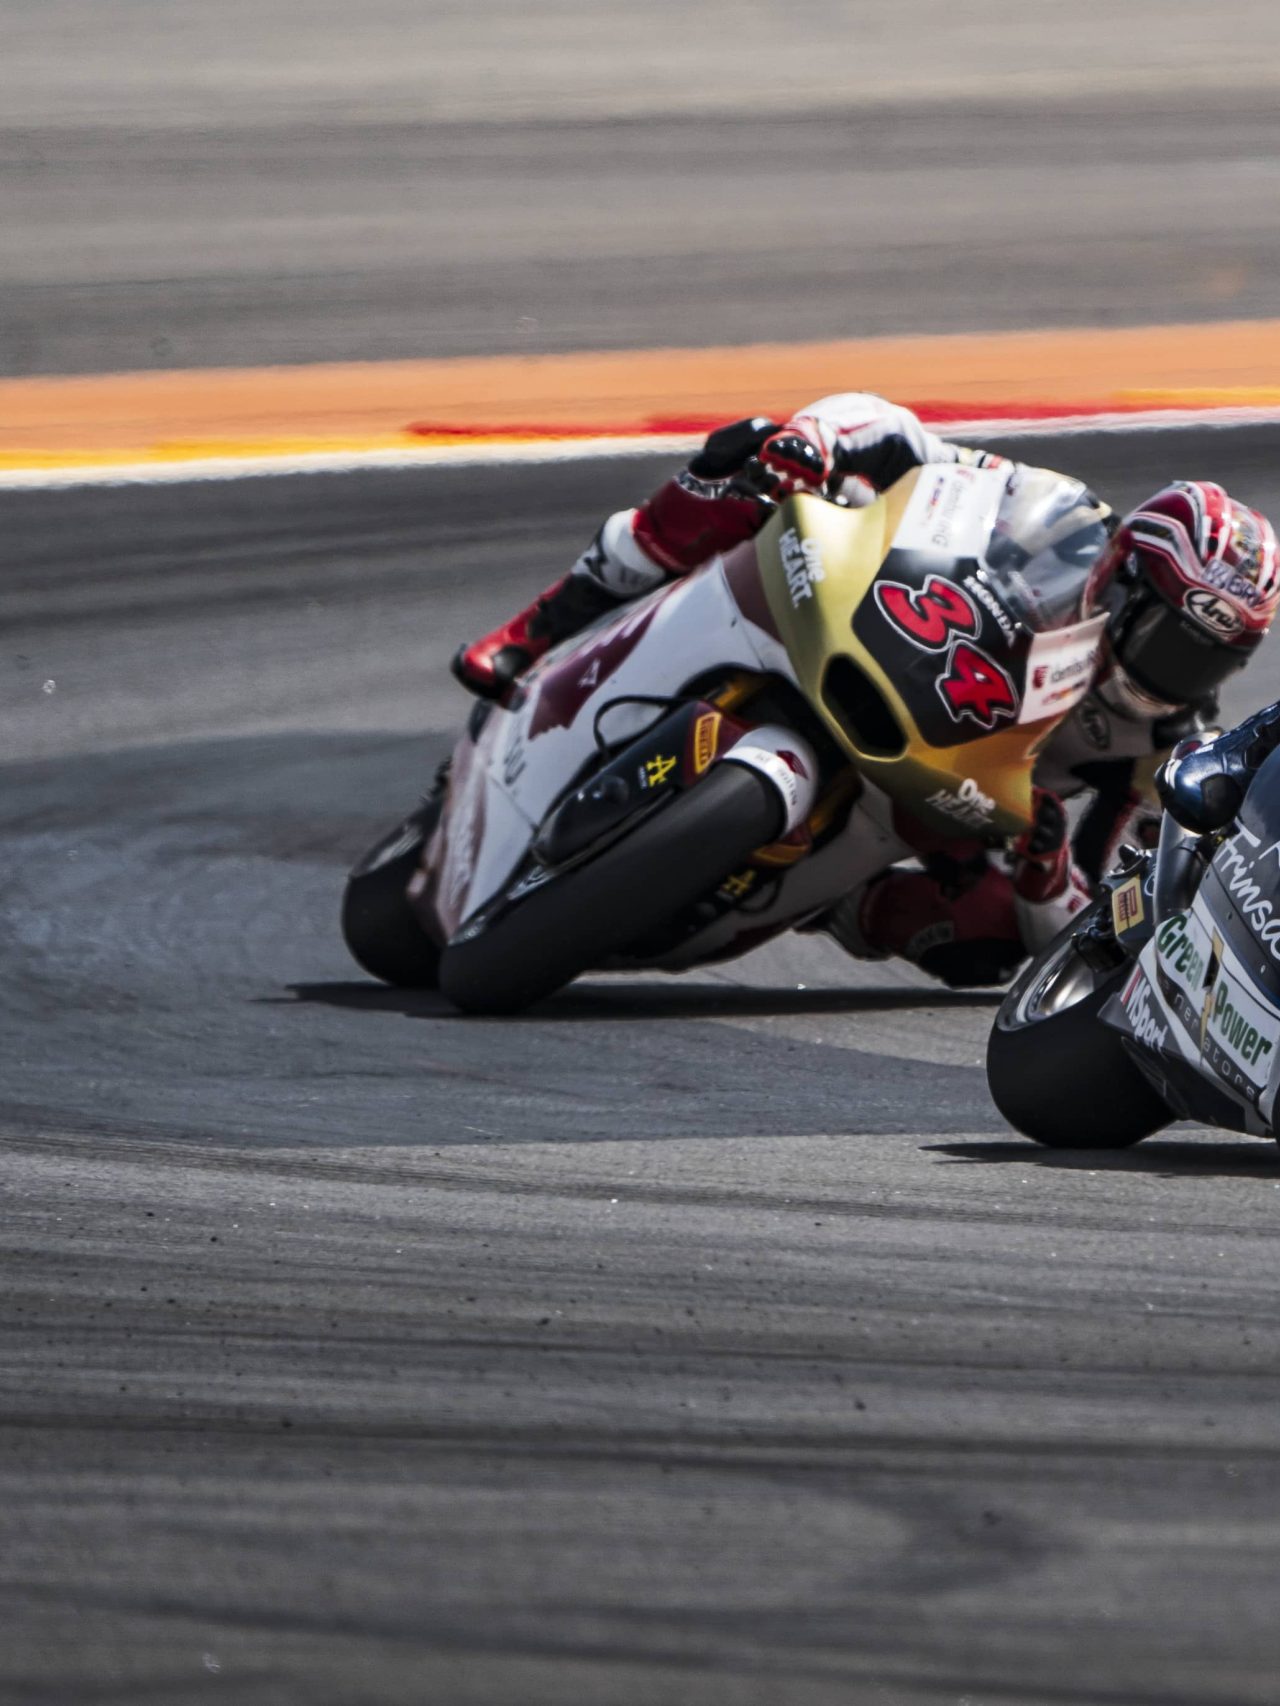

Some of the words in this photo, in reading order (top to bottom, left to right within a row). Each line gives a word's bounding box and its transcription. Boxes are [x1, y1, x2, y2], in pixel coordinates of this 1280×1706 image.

[801, 538, 826, 583] One
[873, 573, 1020, 728] 34
[1155, 914, 1205, 991] Green
[1210, 981, 1272, 1067] Power
